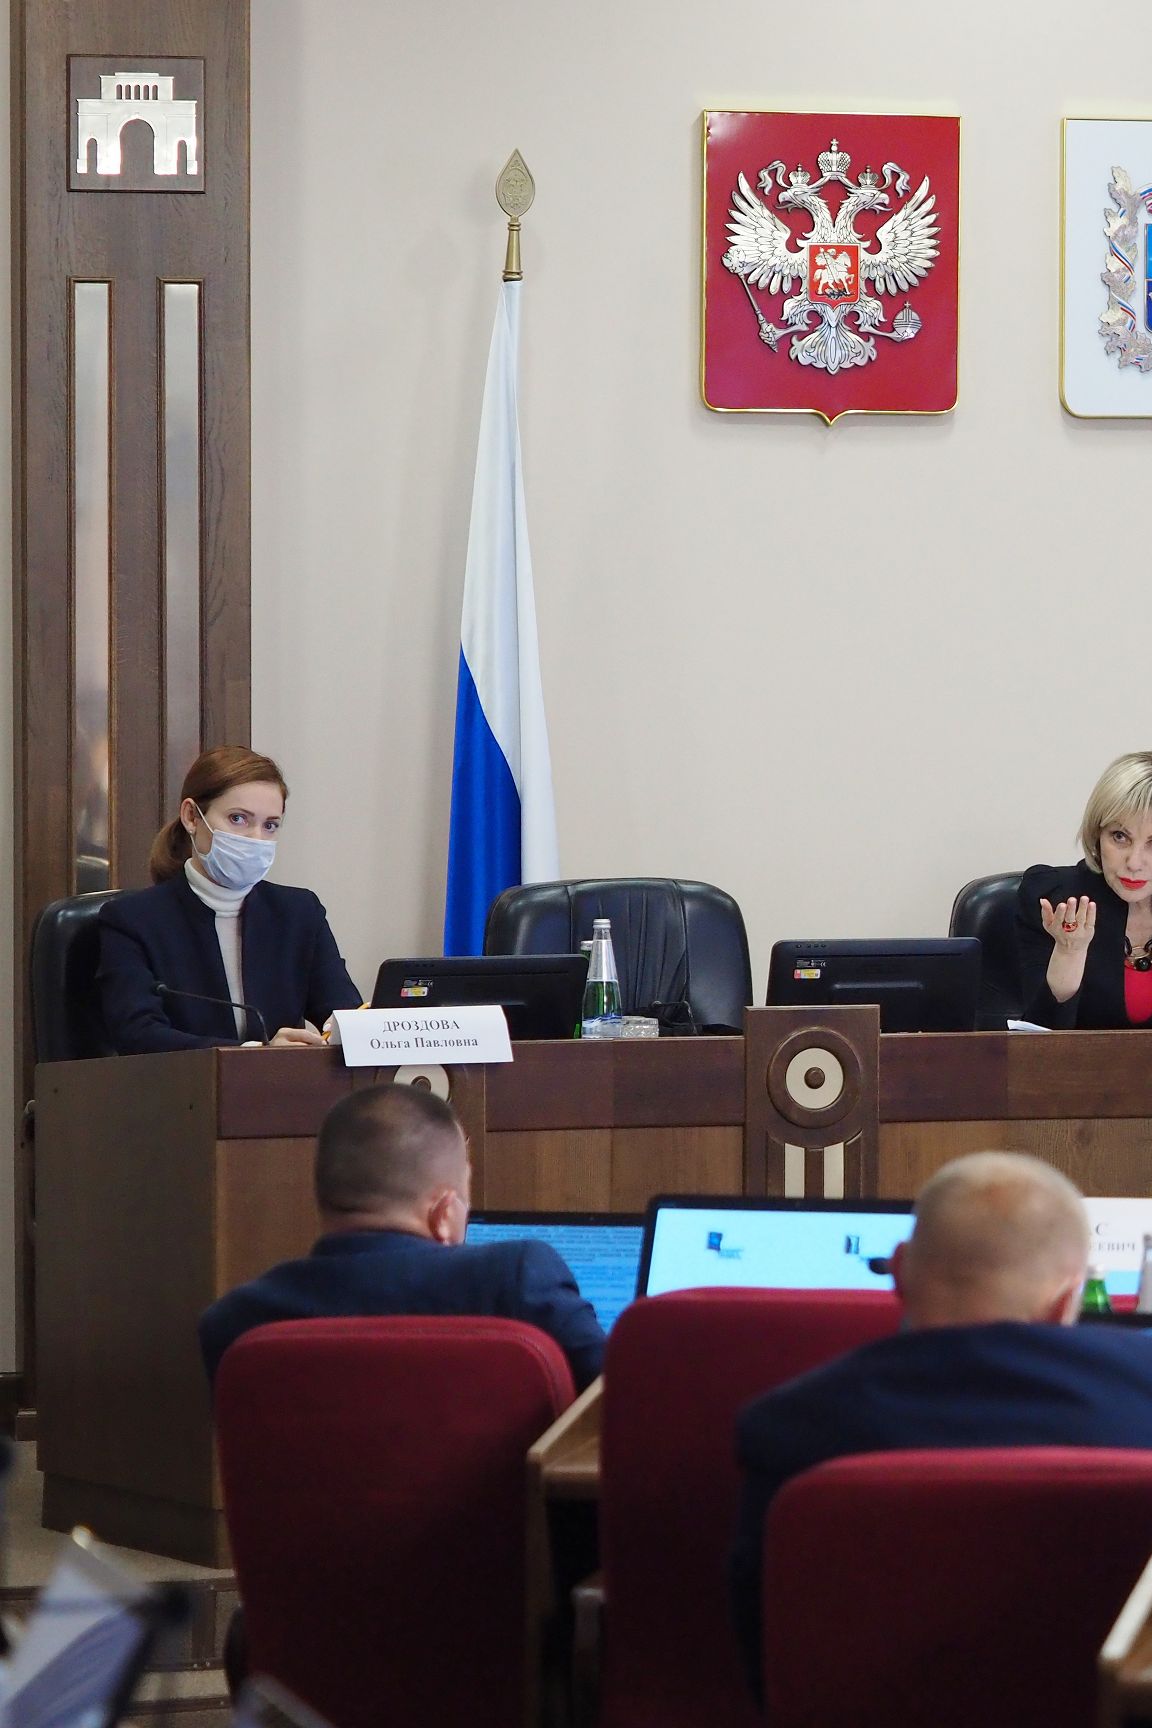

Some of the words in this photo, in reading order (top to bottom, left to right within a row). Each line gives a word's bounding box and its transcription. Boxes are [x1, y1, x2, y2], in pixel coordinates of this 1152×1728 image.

[382, 1019, 460, 1033] ДРОЗДОВА
[370, 1038, 411, 1051] Ольга
[414, 1036, 479, 1050] Павловна
